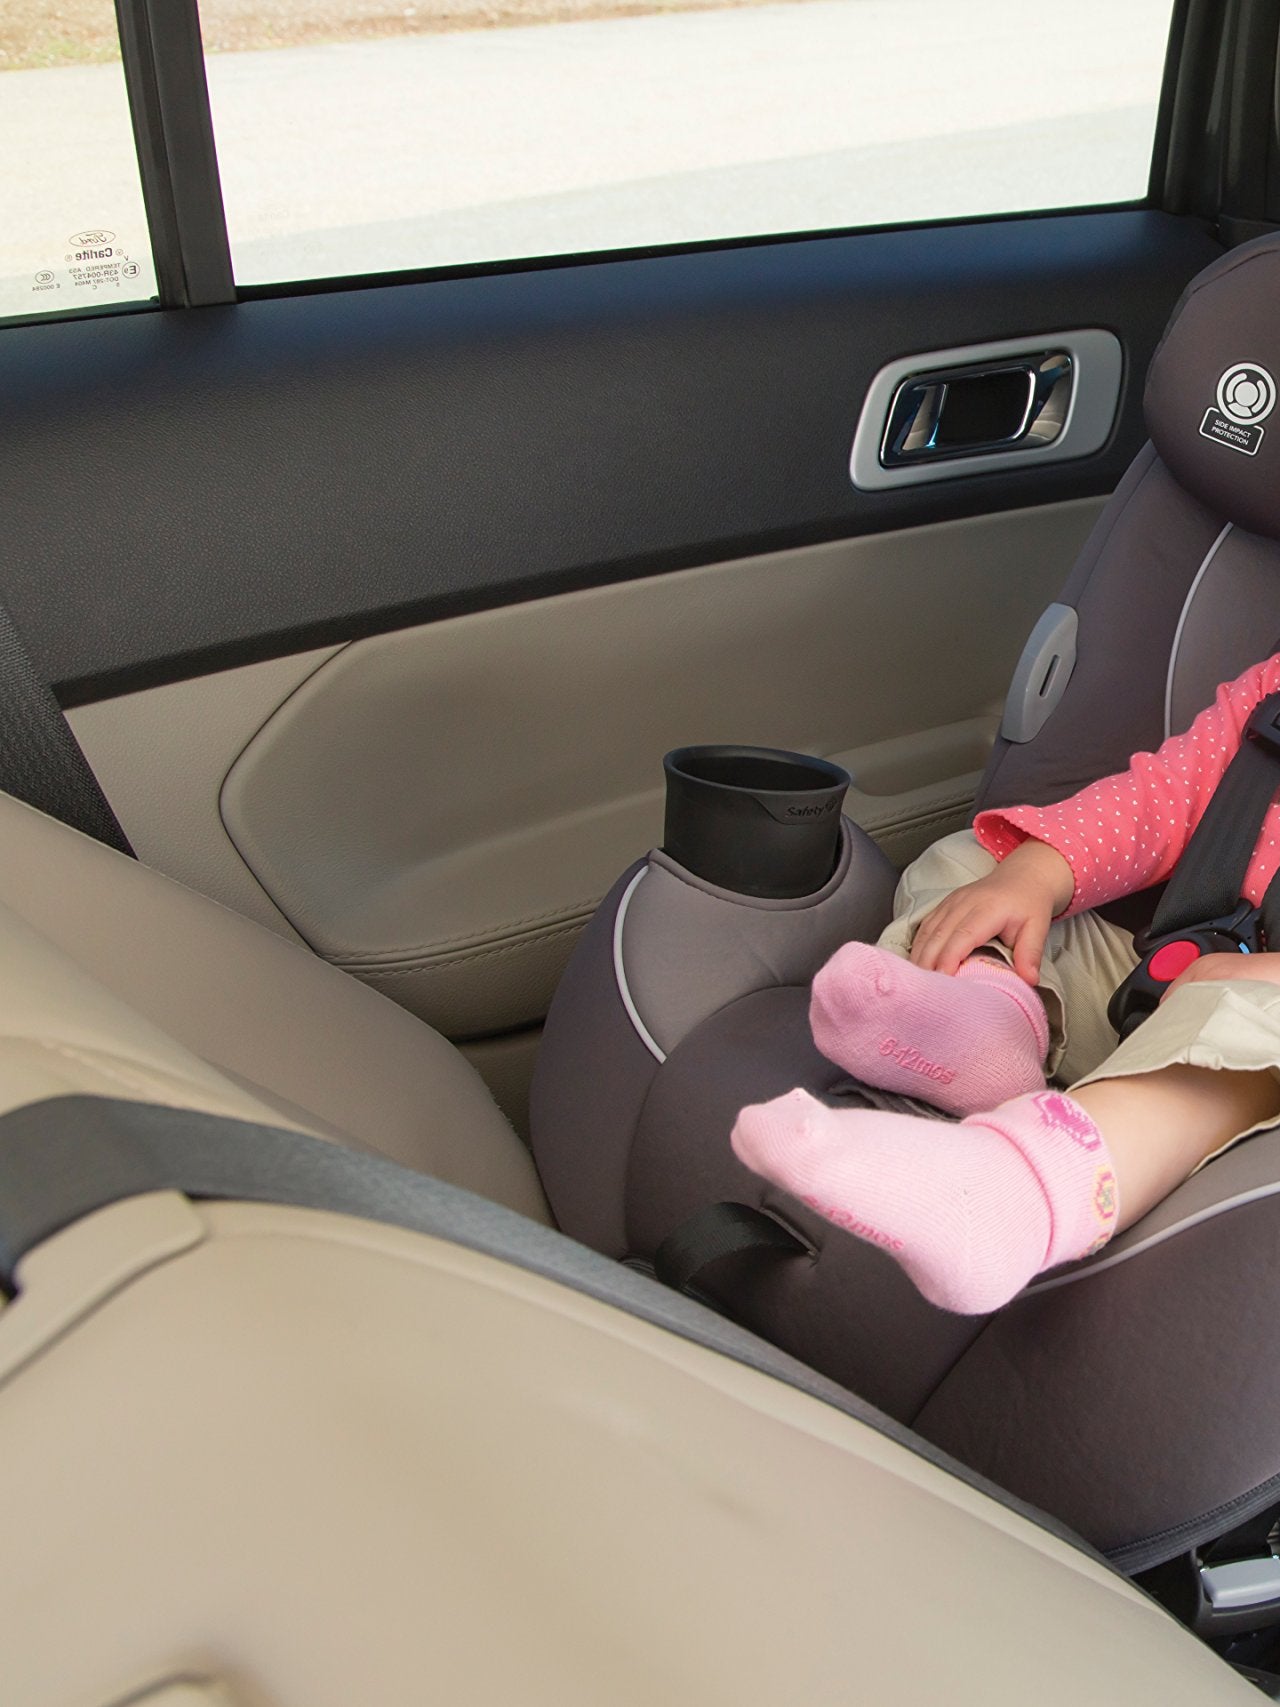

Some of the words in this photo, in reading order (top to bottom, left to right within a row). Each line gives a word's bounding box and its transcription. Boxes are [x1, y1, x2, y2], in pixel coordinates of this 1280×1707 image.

[1211, 426, 1249, 445] PROTECTION
[1214, 419, 1229, 430] SIDE
[1229, 425, 1252, 438] IMPACT
